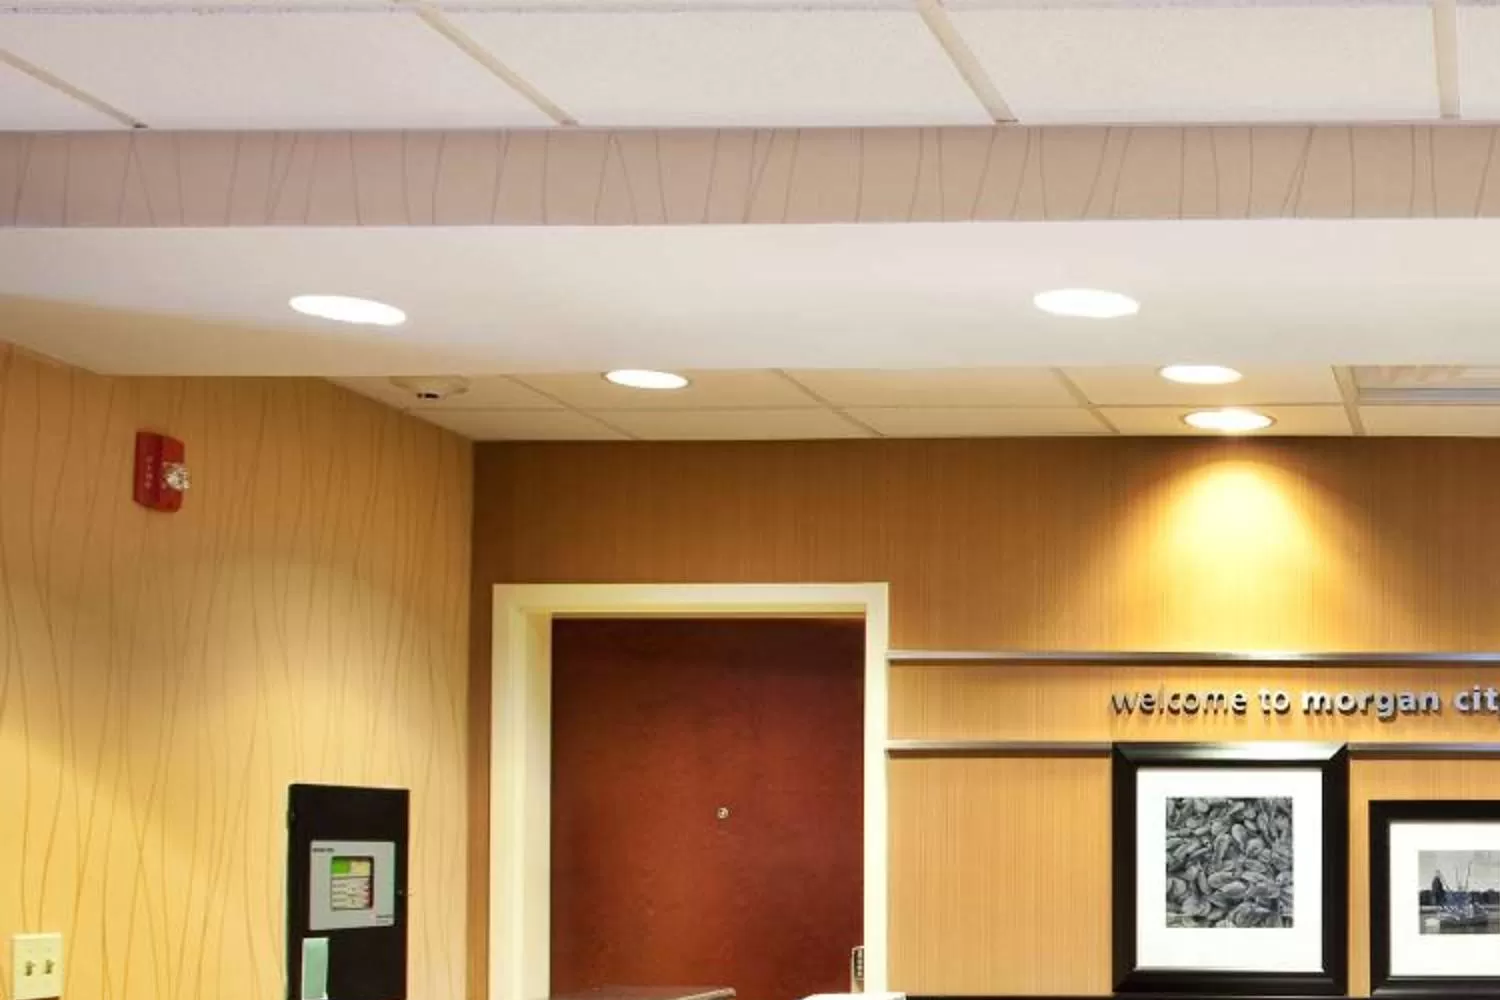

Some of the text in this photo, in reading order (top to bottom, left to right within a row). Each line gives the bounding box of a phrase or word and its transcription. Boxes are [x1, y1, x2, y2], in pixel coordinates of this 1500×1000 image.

[1111, 685, 1248, 714] welcome
[1259, 688, 1291, 714] to
[1301, 690, 1441, 721] morgan
